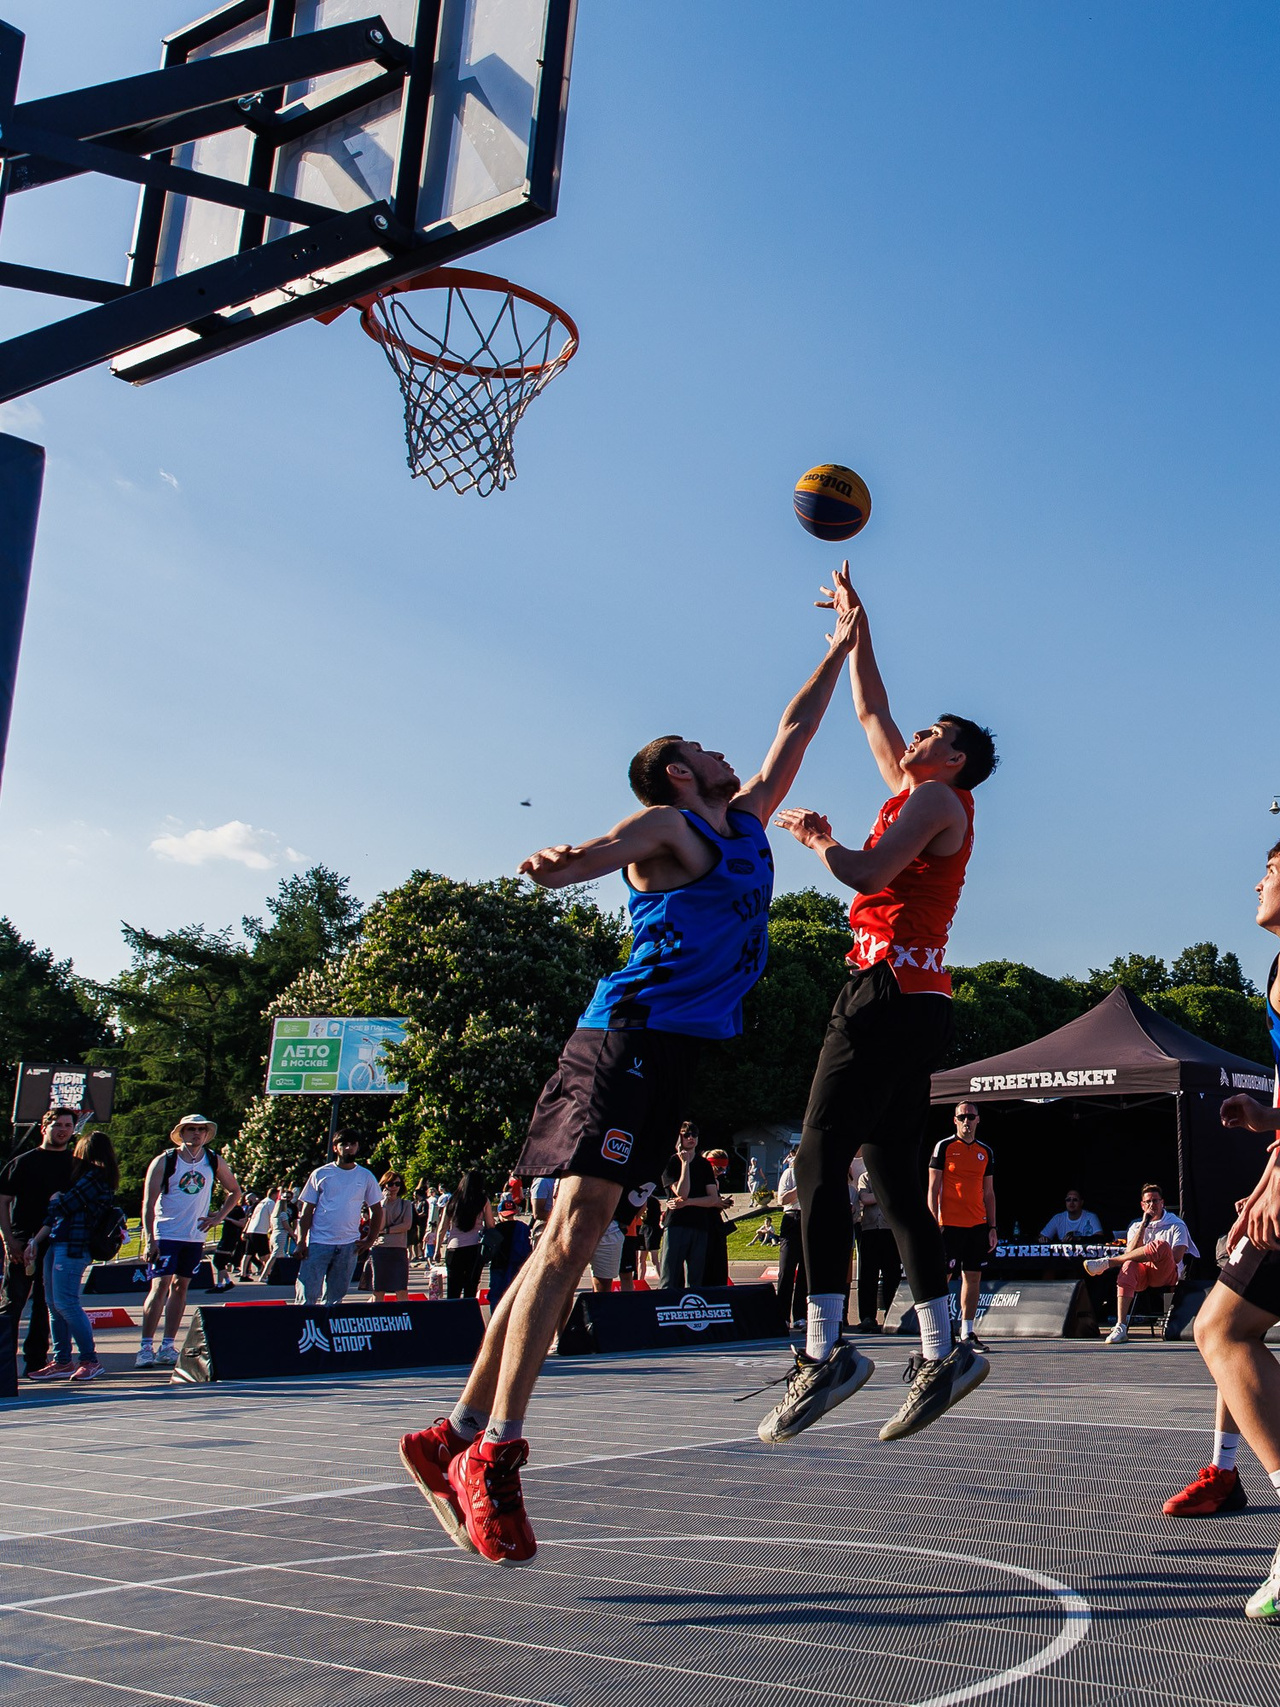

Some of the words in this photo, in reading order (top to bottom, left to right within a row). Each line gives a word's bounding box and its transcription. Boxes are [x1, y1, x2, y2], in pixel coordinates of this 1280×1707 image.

[282, 1044, 330, 1058] ЛЕТО
[970, 1069, 1117, 1093] STREETBASKET
[977, 1290, 1021, 1307] КОВСКИЙ
[329, 1312, 412, 1334] МОСКОВСКИЙ
[656, 1308, 732, 1321] STREETBASKET
[333, 1335, 372, 1352] СПОРТ
